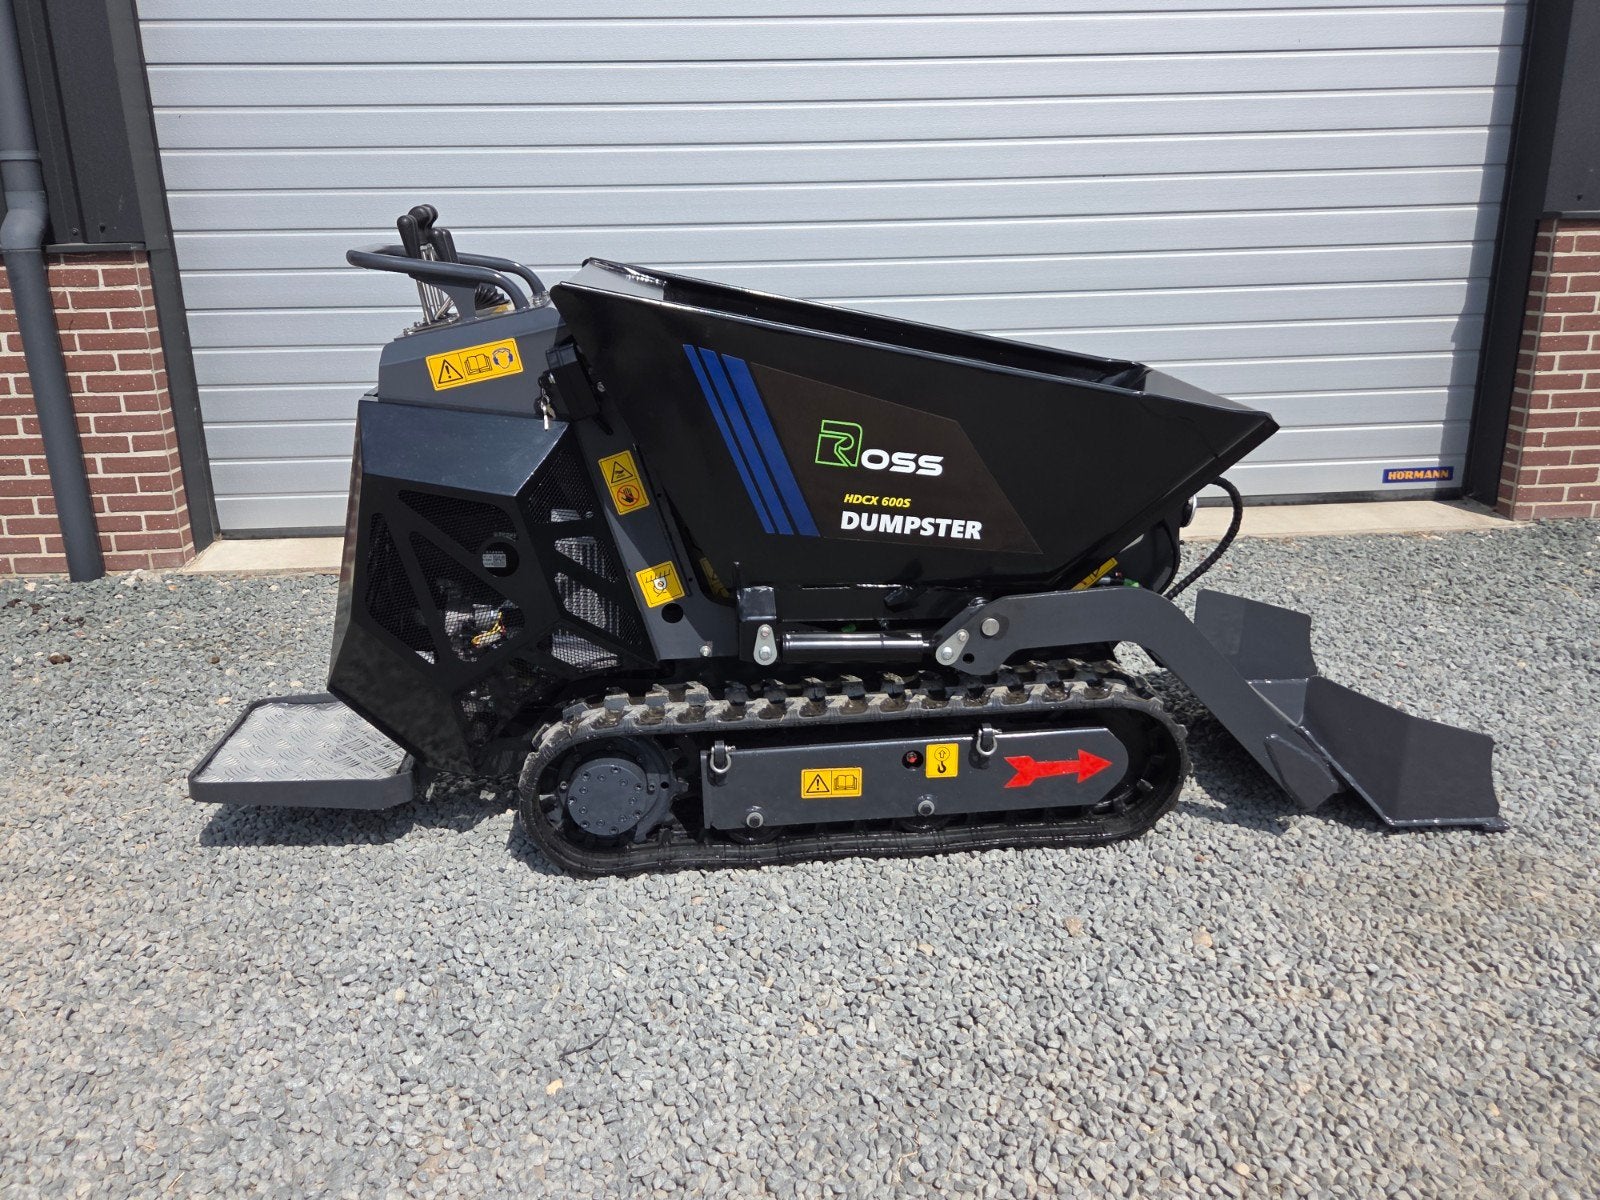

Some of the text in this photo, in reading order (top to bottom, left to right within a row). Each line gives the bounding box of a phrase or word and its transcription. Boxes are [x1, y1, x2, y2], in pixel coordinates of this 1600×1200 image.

[844, 493, 911, 508] HDCX 600S
[841, 510, 983, 540] DUMPSTER
